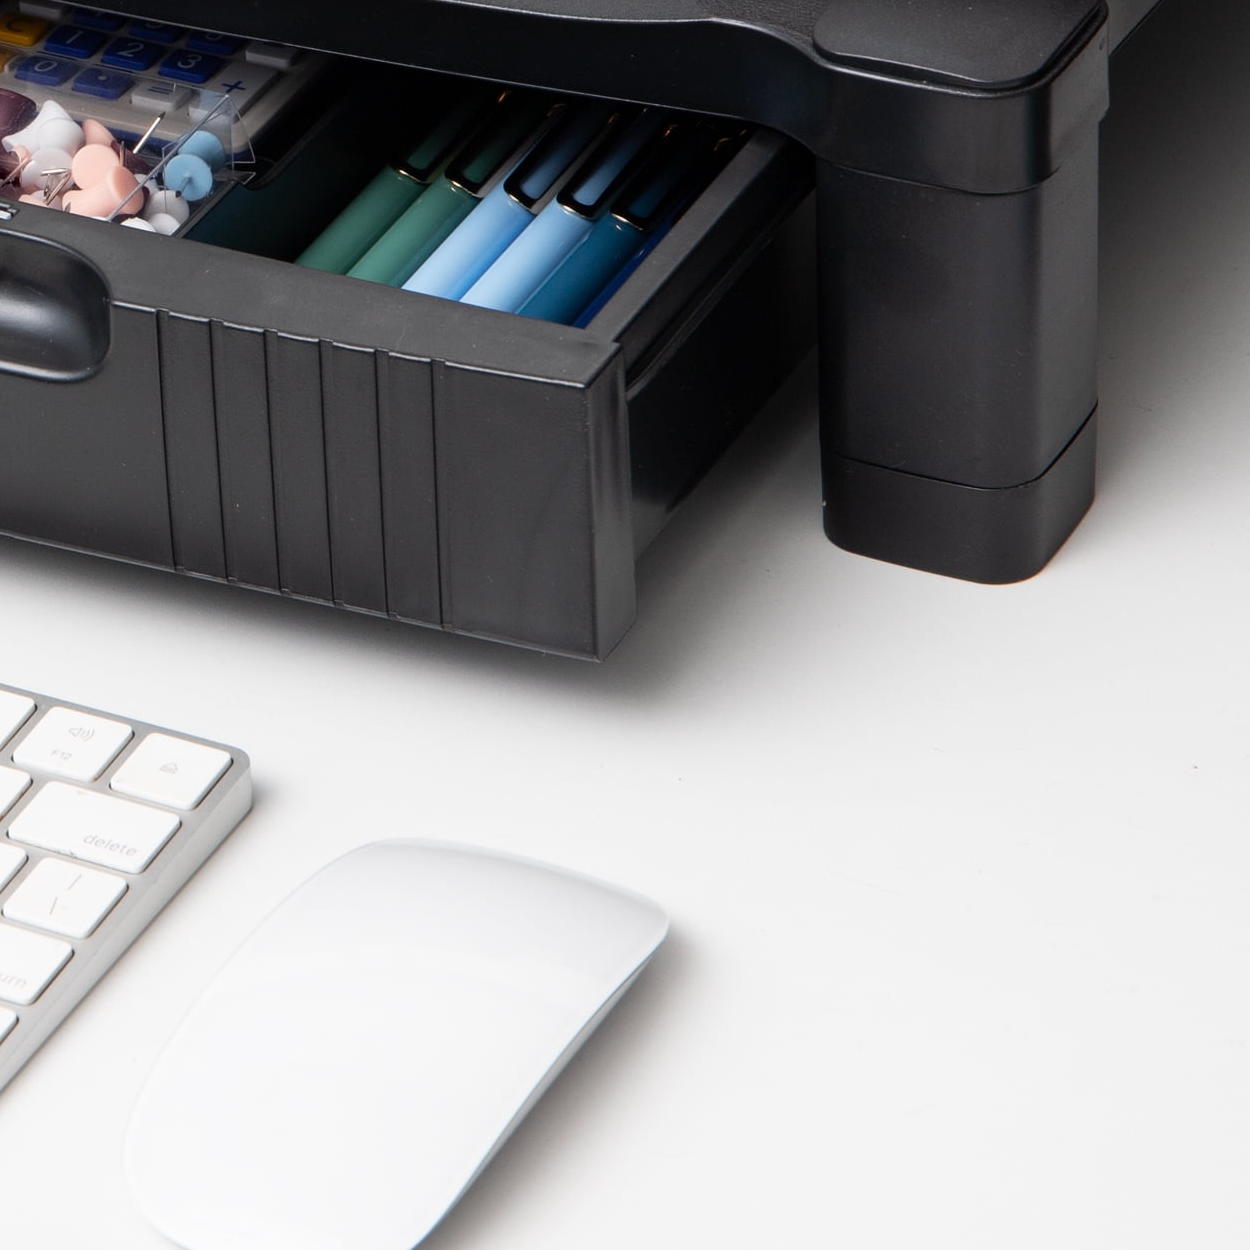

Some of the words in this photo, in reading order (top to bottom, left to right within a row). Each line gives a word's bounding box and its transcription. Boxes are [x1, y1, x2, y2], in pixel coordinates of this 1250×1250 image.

[65, 30, 85, 44] 1
[117, 41, 145, 57] 2
[34, 61, 58, 73] 0
[177, 54, 203, 69] 3
[51, 750, 72, 760] F12
[82, 834, 138, 857] delete
